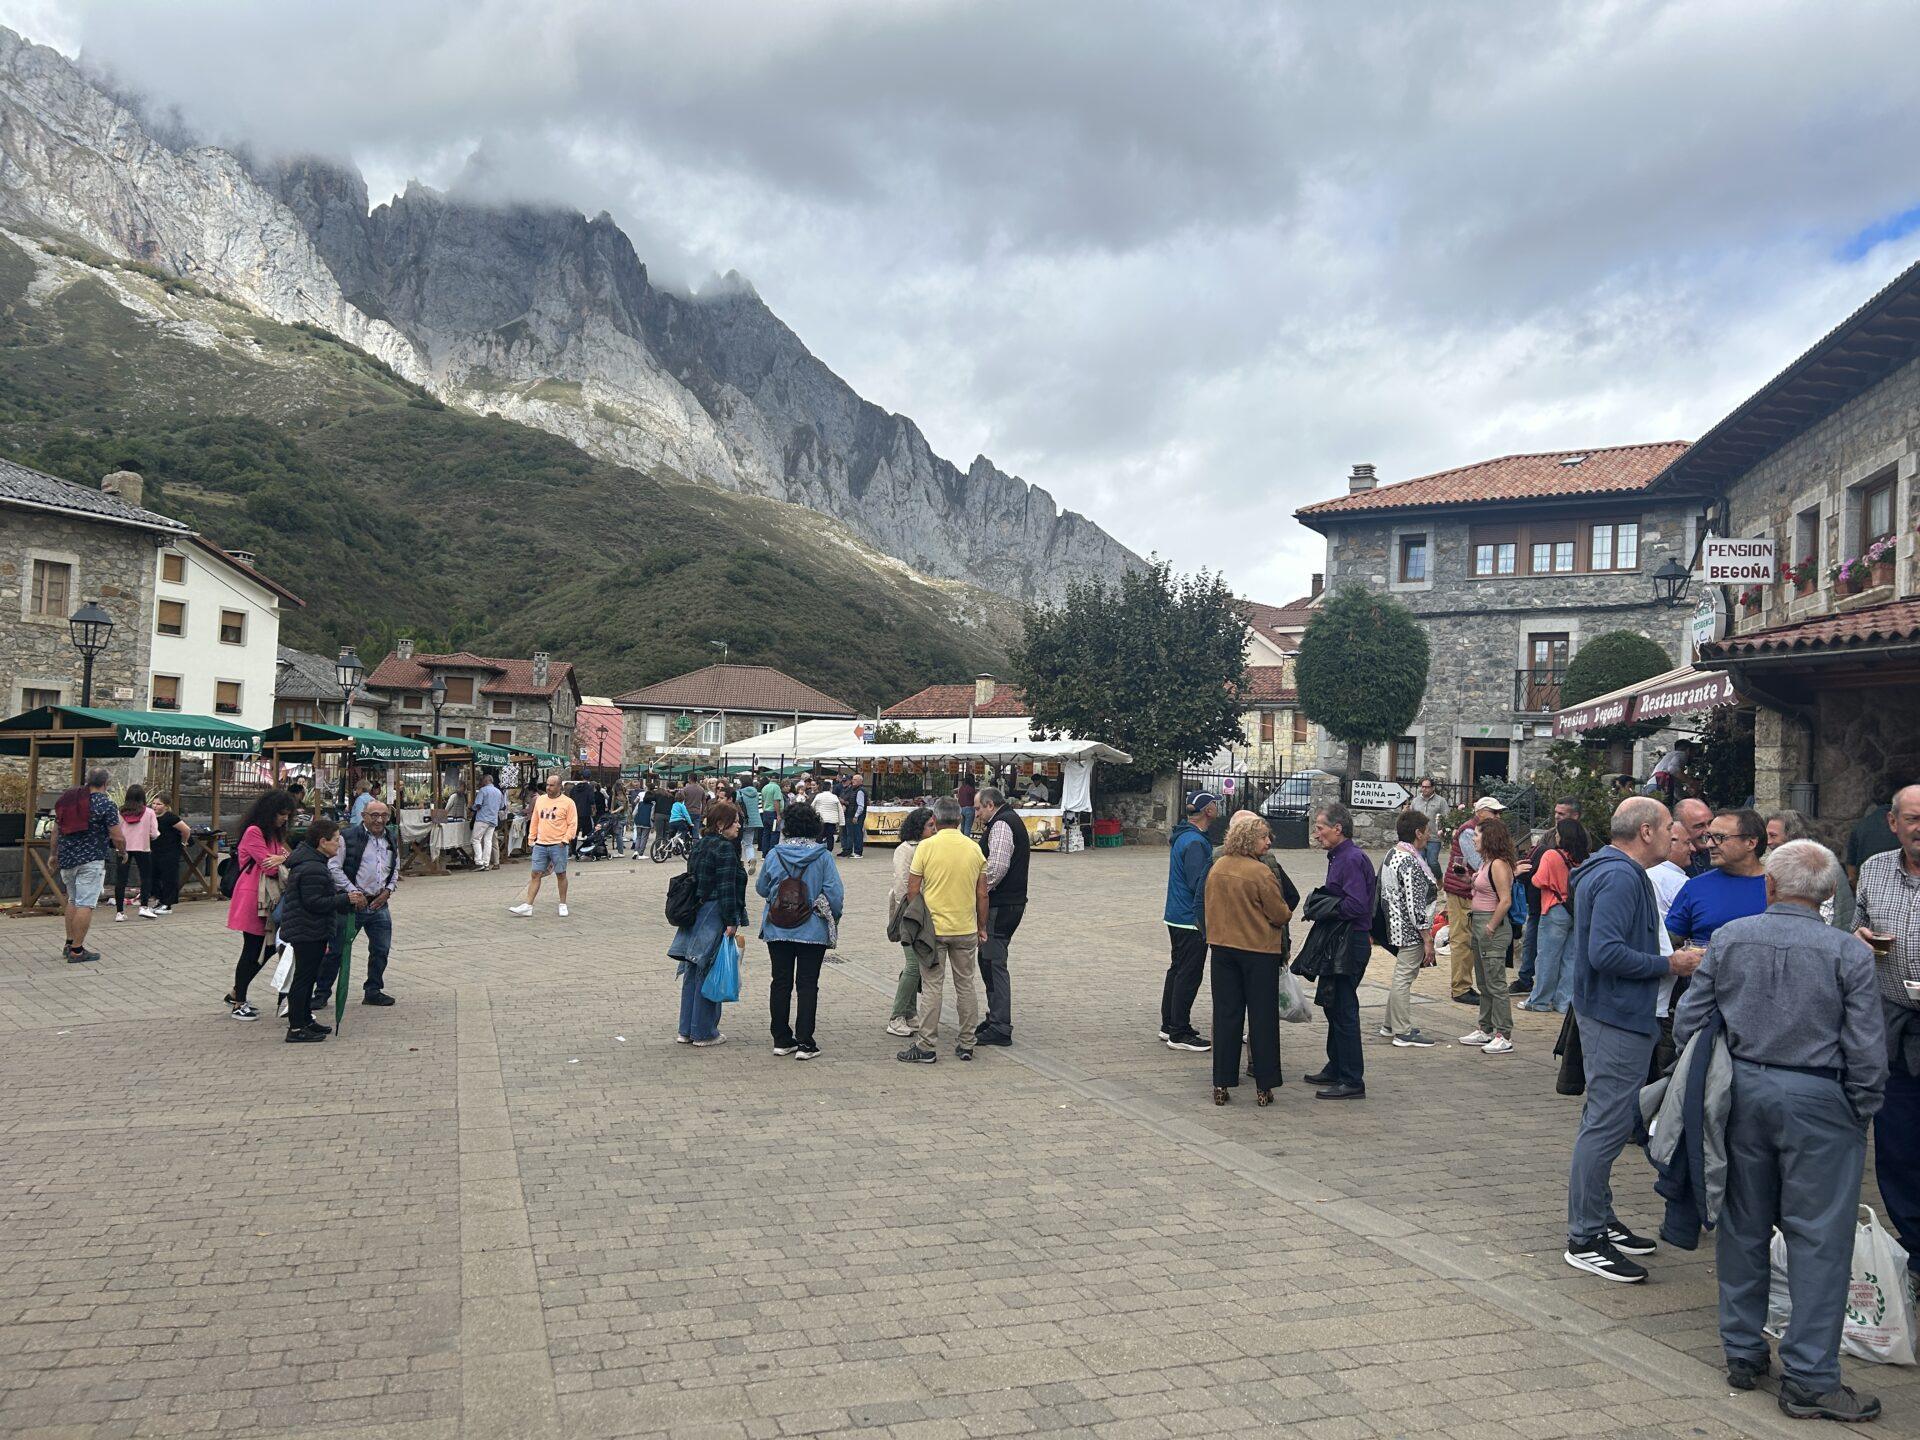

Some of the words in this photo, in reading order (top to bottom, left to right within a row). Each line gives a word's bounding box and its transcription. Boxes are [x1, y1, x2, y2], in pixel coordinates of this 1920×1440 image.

[1708, 544, 1773, 557] PENSION
[1710, 563, 1771, 579] BEGOÑA
[1640, 682, 1718, 713] Restaurante
[1559, 711, 1588, 729] Pensión
[1594, 702, 1624, 724] Begoña
[151, 731, 191, 747] Posada
[193, 734, 206, 748] de
[208, 735, 248, 749] Valdeón
[1354, 781, 1383, 789] SANTA
